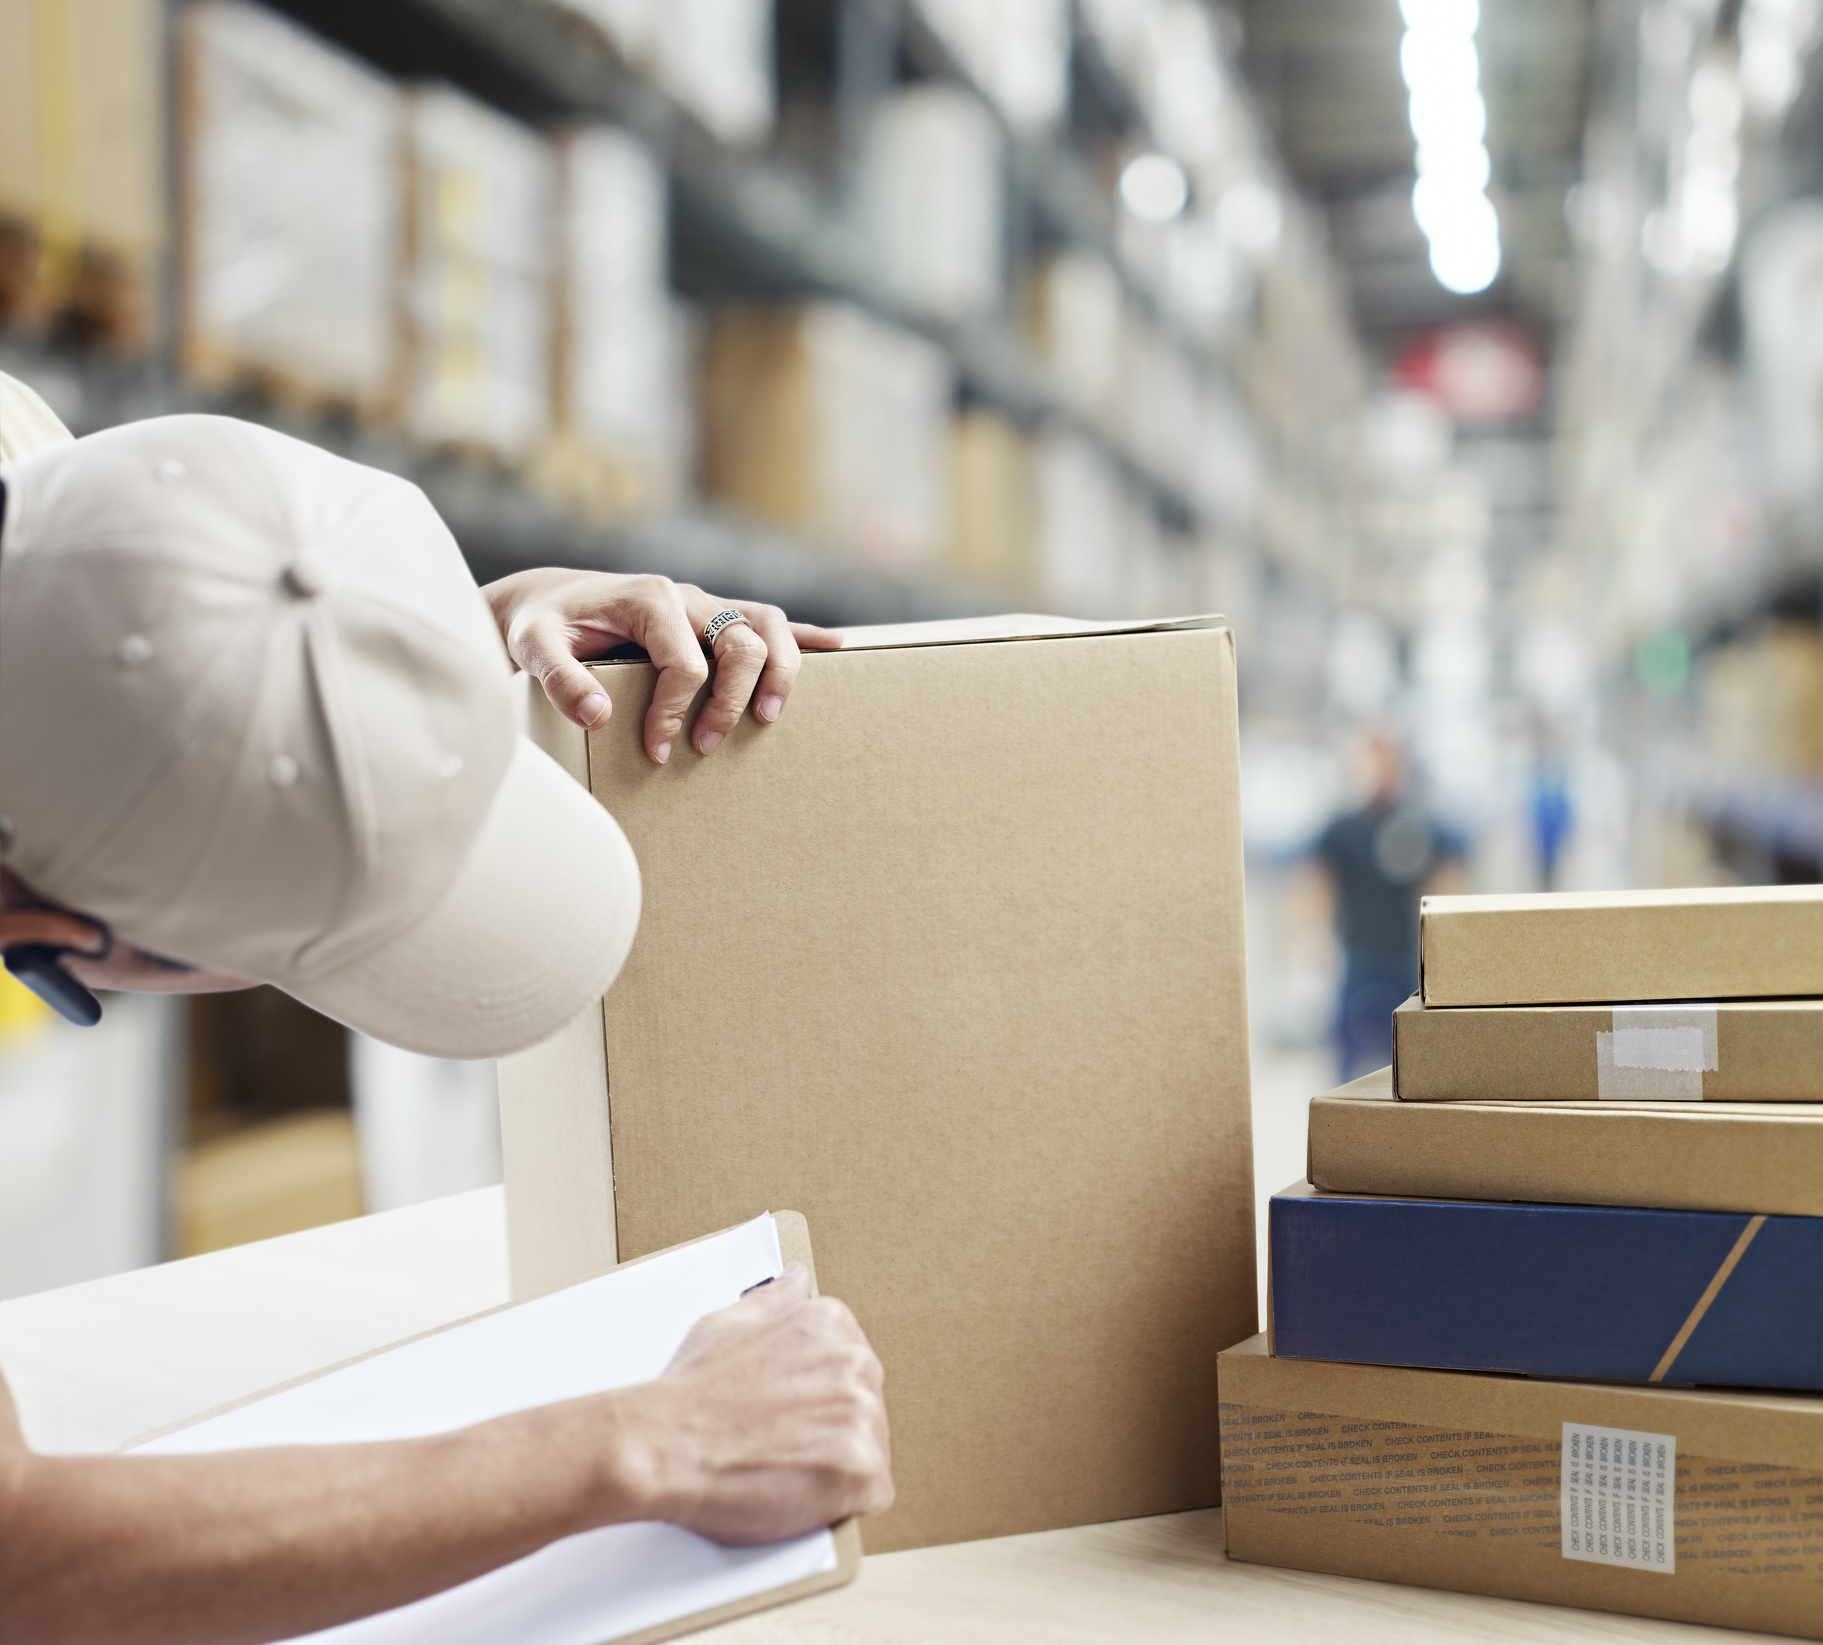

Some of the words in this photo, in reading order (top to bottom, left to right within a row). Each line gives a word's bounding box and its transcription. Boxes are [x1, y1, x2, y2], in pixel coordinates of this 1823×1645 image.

[1222, 1418, 1240, 1426] SEAL
[1252, 1415, 1285, 1424] BROKEN
[1264, 1431, 1283, 1439] SEAL
[1295, 1428, 1328, 1436] BROKEN
[1342, 1424, 1370, 1433] CHECK
[1224, 1449, 1250, 1457] CHECK
[1252, 1445, 1294, 1456] CONTENTS
[1297, 1444, 1304, 1452] IF
[1306, 1443, 1326, 1451] SEAL
[1338, 1440, 1372, 1449] BROKEN
[1385, 1437, 1414, 1446] CHECK
[1417, 1433, 1462, 1444] CONTENTS
[1464, 1432, 1472, 1440] IF
[1572, 1433, 1580, 1458] BROKEN
[1586, 1435, 1594, 1460] BROKEN
[1600, 1437, 1608, 1462] BROKEN
[1614, 1439, 1622, 1464] BROKEN
[1628, 1441, 1636, 1466] BROKEN
[1223, 1464, 1254, 1473] BROKEN
[1266, 1462, 1293, 1470] CHECK
[1296, 1459, 1339, 1468] CONTENTS
[1350, 1456, 1370, 1465] SEAL
[1382, 1454, 1417, 1462] BROKEN
[1431, 1450, 1460, 1459] CHECK
[1463, 1447, 1508, 1457] CONTENTS
[1521, 1445, 1542, 1453] SEAL
[1545, 1443, 1553, 1451] IS
[1657, 1444, 1665, 1469] BROKEN
[1234, 1479, 1253, 1488] SEAL
[1255, 1478, 1262, 1486] IS
[1264, 1477, 1297, 1486] BROKEN
[1310, 1474, 1337, 1483] CHECK
[1340, 1472, 1383, 1481] CONTENTS
[1394, 1469, 1415, 1478] SEAL
[1418, 1468, 1425, 1476] IS
[1428, 1466, 1463, 1476] BROKEN
[1476, 1464, 1506, 1472] CHECK
[1509, 1460, 1555, 1470] CONTENTS
[1571, 1471, 1579, 1484] SEAL
[1585, 1473, 1593, 1486] SEAL
[1599, 1475, 1607, 1488] SEAL
[1614, 1477, 1622, 1490] SEAL
[1628, 1479, 1636, 1491] SEAL
[1224, 1495, 1265, 1504] CONTENTS
[1277, 1492, 1296, 1501] SEAL
[1308, 1490, 1340, 1498] BROKEN
[1354, 1488, 1382, 1496] CHECK
[1384, 1485, 1428, 1494] CONTENTS
[1431, 1484, 1438, 1492] IF
[1440, 1483, 1461, 1491] SEAL
[1464, 1482, 1471, 1490] IS
[1473, 1480, 1509, 1490] BROKEN
[1523, 1477, 1553, 1486] CHECK
[1642, 1480, 1650, 1493] SEAL
[1656, 1482, 1664, 1495] SEAL
[1320, 1505, 1340, 1514] SEAL
[1342, 1504, 1348, 1512] IS
[1351, 1503, 1384, 1512] BROKEN
[1398, 1500, 1426, 1508] CHECK
[1429, 1498, 1474, 1508] CONTENTS
[1486, 1496, 1507, 1504] SEAL
[1509, 1495, 1517, 1503] IS
[1520, 1493, 1555, 1502] BROKEN
[1571, 1496, 1579, 1527] CONTENTS
[1585, 1498, 1593, 1529] CONTENTS
[1386, 1518, 1393, 1526] IS
[1396, 1516, 1430, 1525] BROKEN
[1444, 1514, 1472, 1522] CHECK
[1475, 1511, 1521, 1521] CONTENTS
[1533, 1510, 1554, 1518] SEAL
[1599, 1500, 1607, 1531] CONTENTS
[1613, 1501, 1622, 1533] CONTENTS
[1627, 1503, 1636, 1535] CONTENTS
[1642, 1505, 1650, 1536] CONTENTS
[1656, 1507, 1664, 1538] CONTENTS
[1490, 1528, 1519, 1536] CHECK
[1522, 1526, 1561, 1534] CONTENT
[1571, 1530, 1579, 1550] CHECK
[1614, 1536, 1622, 1556] CHECK
[1628, 1537, 1636, 1558] CHECK
[1642, 1539, 1650, 1560] CHECK
[1656, 1541, 1664, 1562] CHECK
